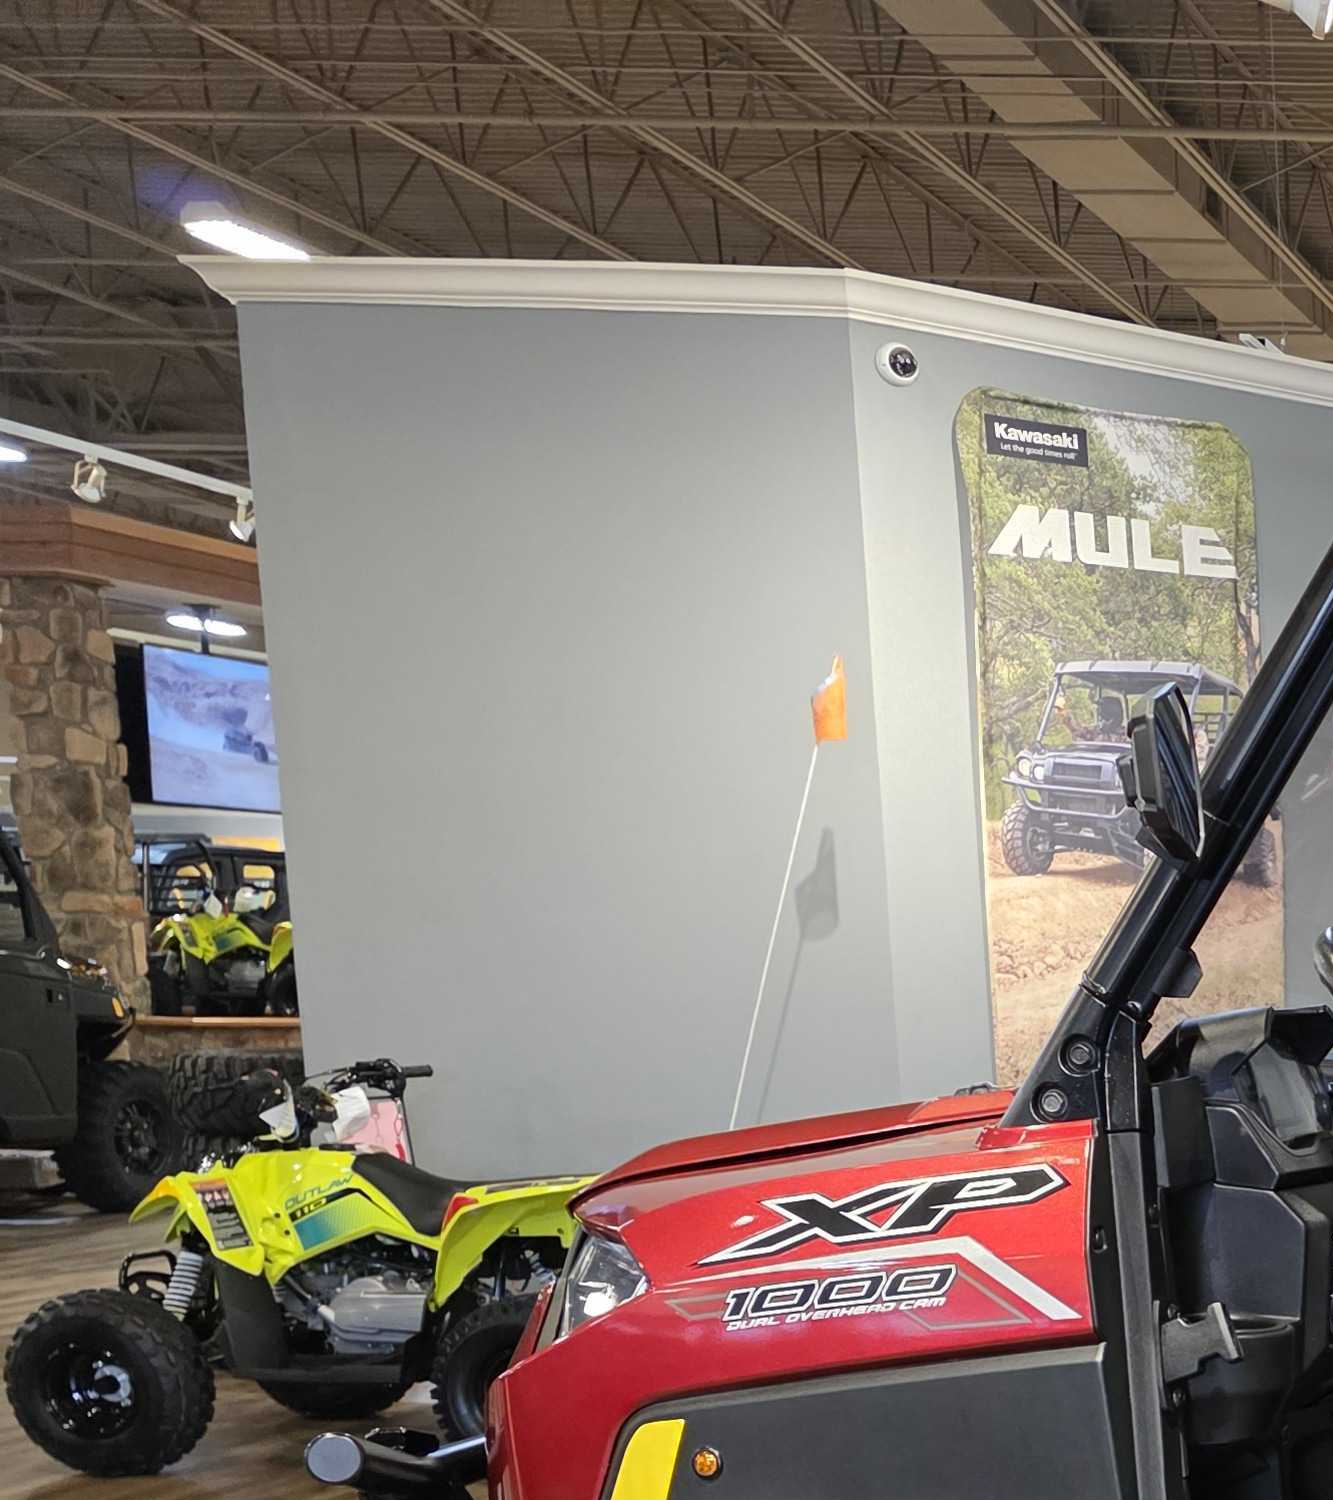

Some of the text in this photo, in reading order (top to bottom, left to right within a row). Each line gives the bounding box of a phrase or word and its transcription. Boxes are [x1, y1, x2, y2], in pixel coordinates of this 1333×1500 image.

[994, 422, 1079, 449] Kawasaki
[988, 503, 1239, 579] MULE
[284, 1171, 354, 1210] OUTLAW
[295, 1197, 327, 1218] 110
[692, 1162, 1072, 1268] XP
[722, 1264, 957, 1322] 1000
[726, 1297, 947, 1332] DUAL OVERHEAD CAM
